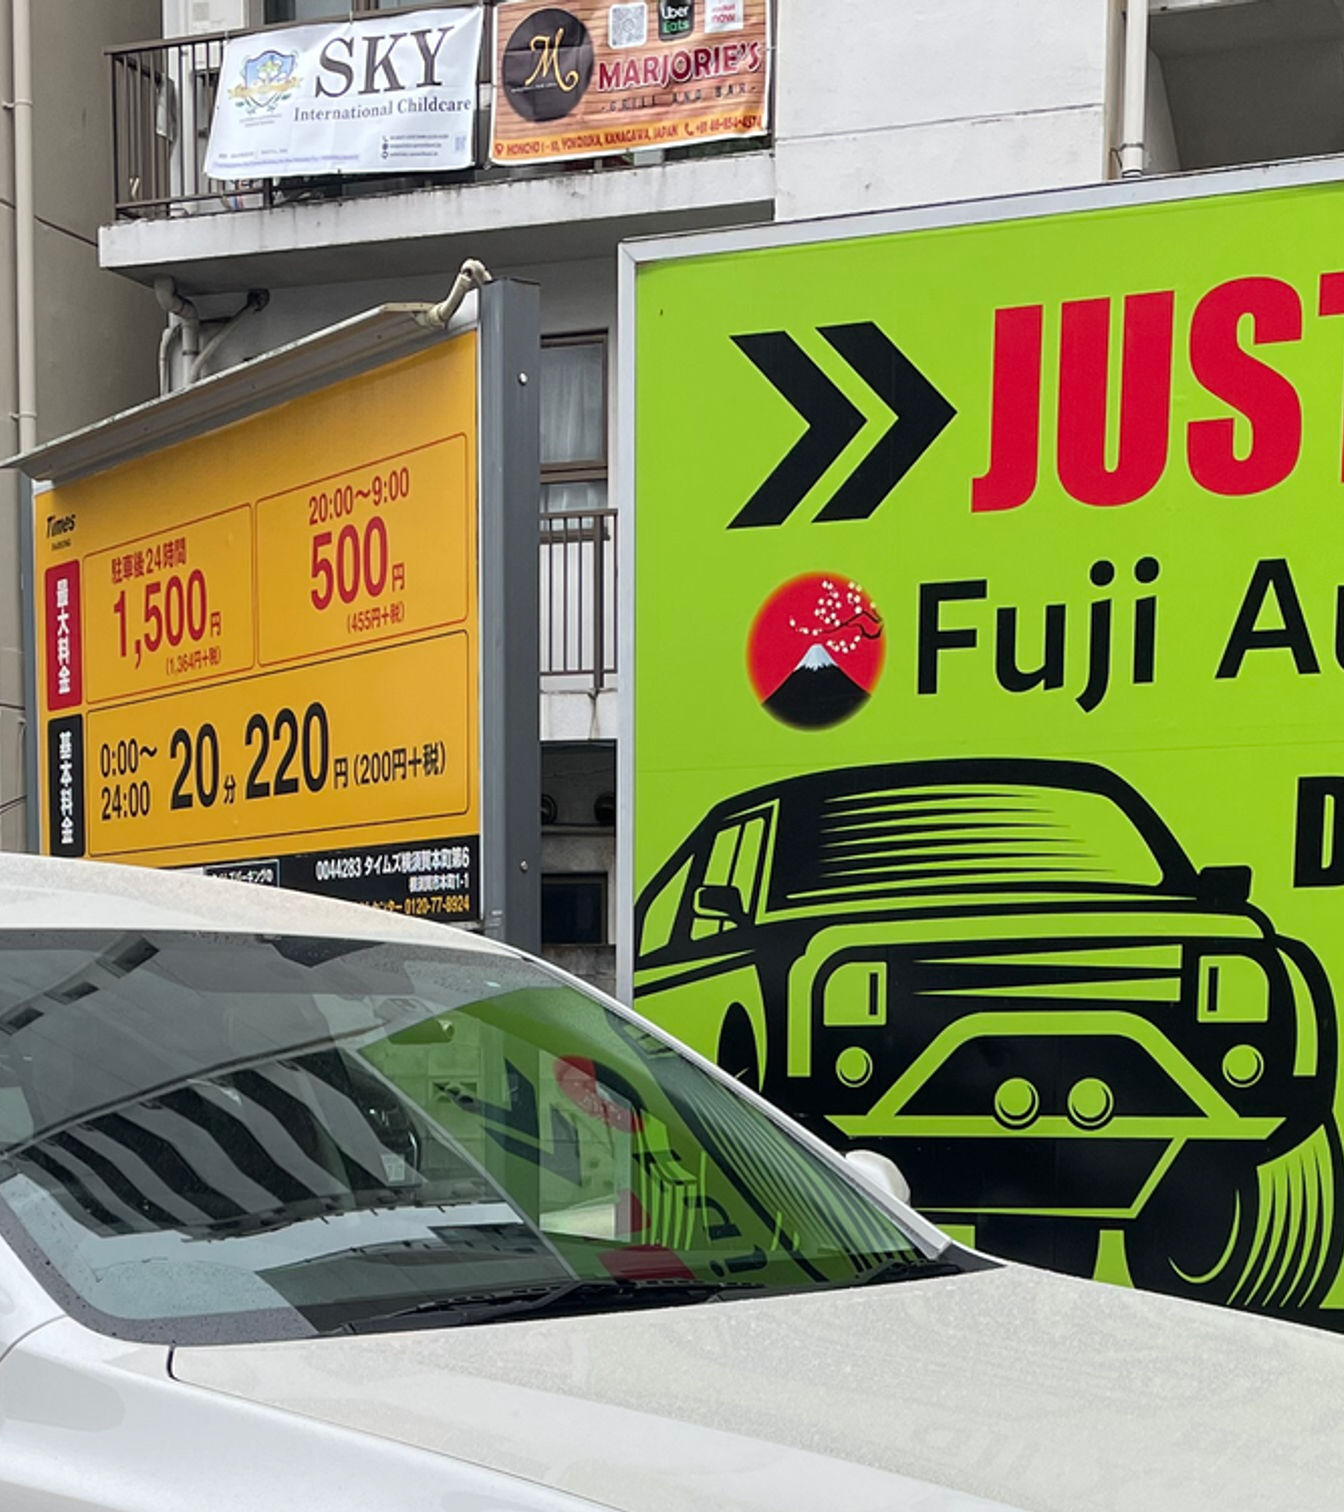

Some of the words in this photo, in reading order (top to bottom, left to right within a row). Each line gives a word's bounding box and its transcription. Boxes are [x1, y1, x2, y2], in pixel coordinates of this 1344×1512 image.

[661, 5, 690, 20] Uber
[662, 20, 691, 34] Eats
[315, 26, 455, 98] SKY
[598, 42, 759, 91] MARJORIE'S
[672, 90, 704, 106] AND
[715, 82, 748, 99] BAR
[293, 102, 394, 123] International
[398, 97, 472, 115] Childcare
[653, 123, 678, 140] JAPAN
[47, 514, 77, 538] Times
[57, 578, 71, 694] 最大料金
[918, 557, 1159, 710] Fuji
[59, 731, 74, 844] 基本料金
[101, 781, 152, 822] 24:00
[315, 857, 362, 880] 0044283
